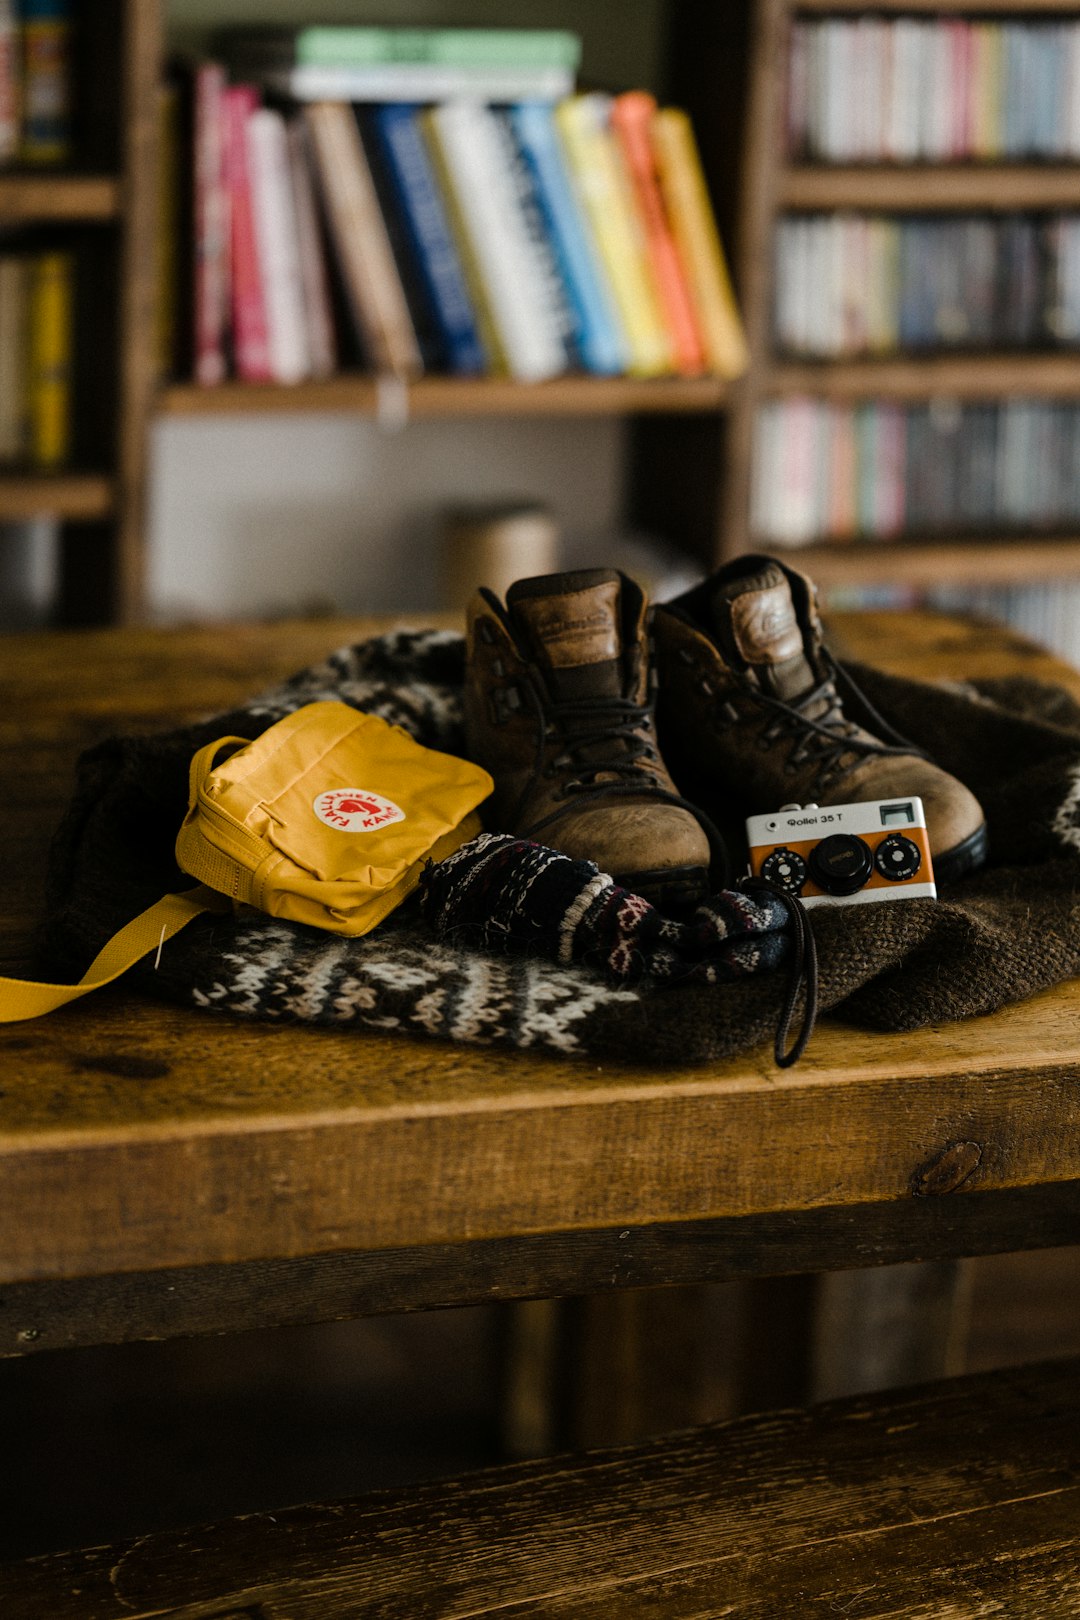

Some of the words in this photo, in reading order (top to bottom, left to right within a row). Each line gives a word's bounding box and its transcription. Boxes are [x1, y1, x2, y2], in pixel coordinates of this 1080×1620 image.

[787, 816, 818, 826] Rollei
[820, 814, 834, 823] 35
[836, 812, 842, 821] T
